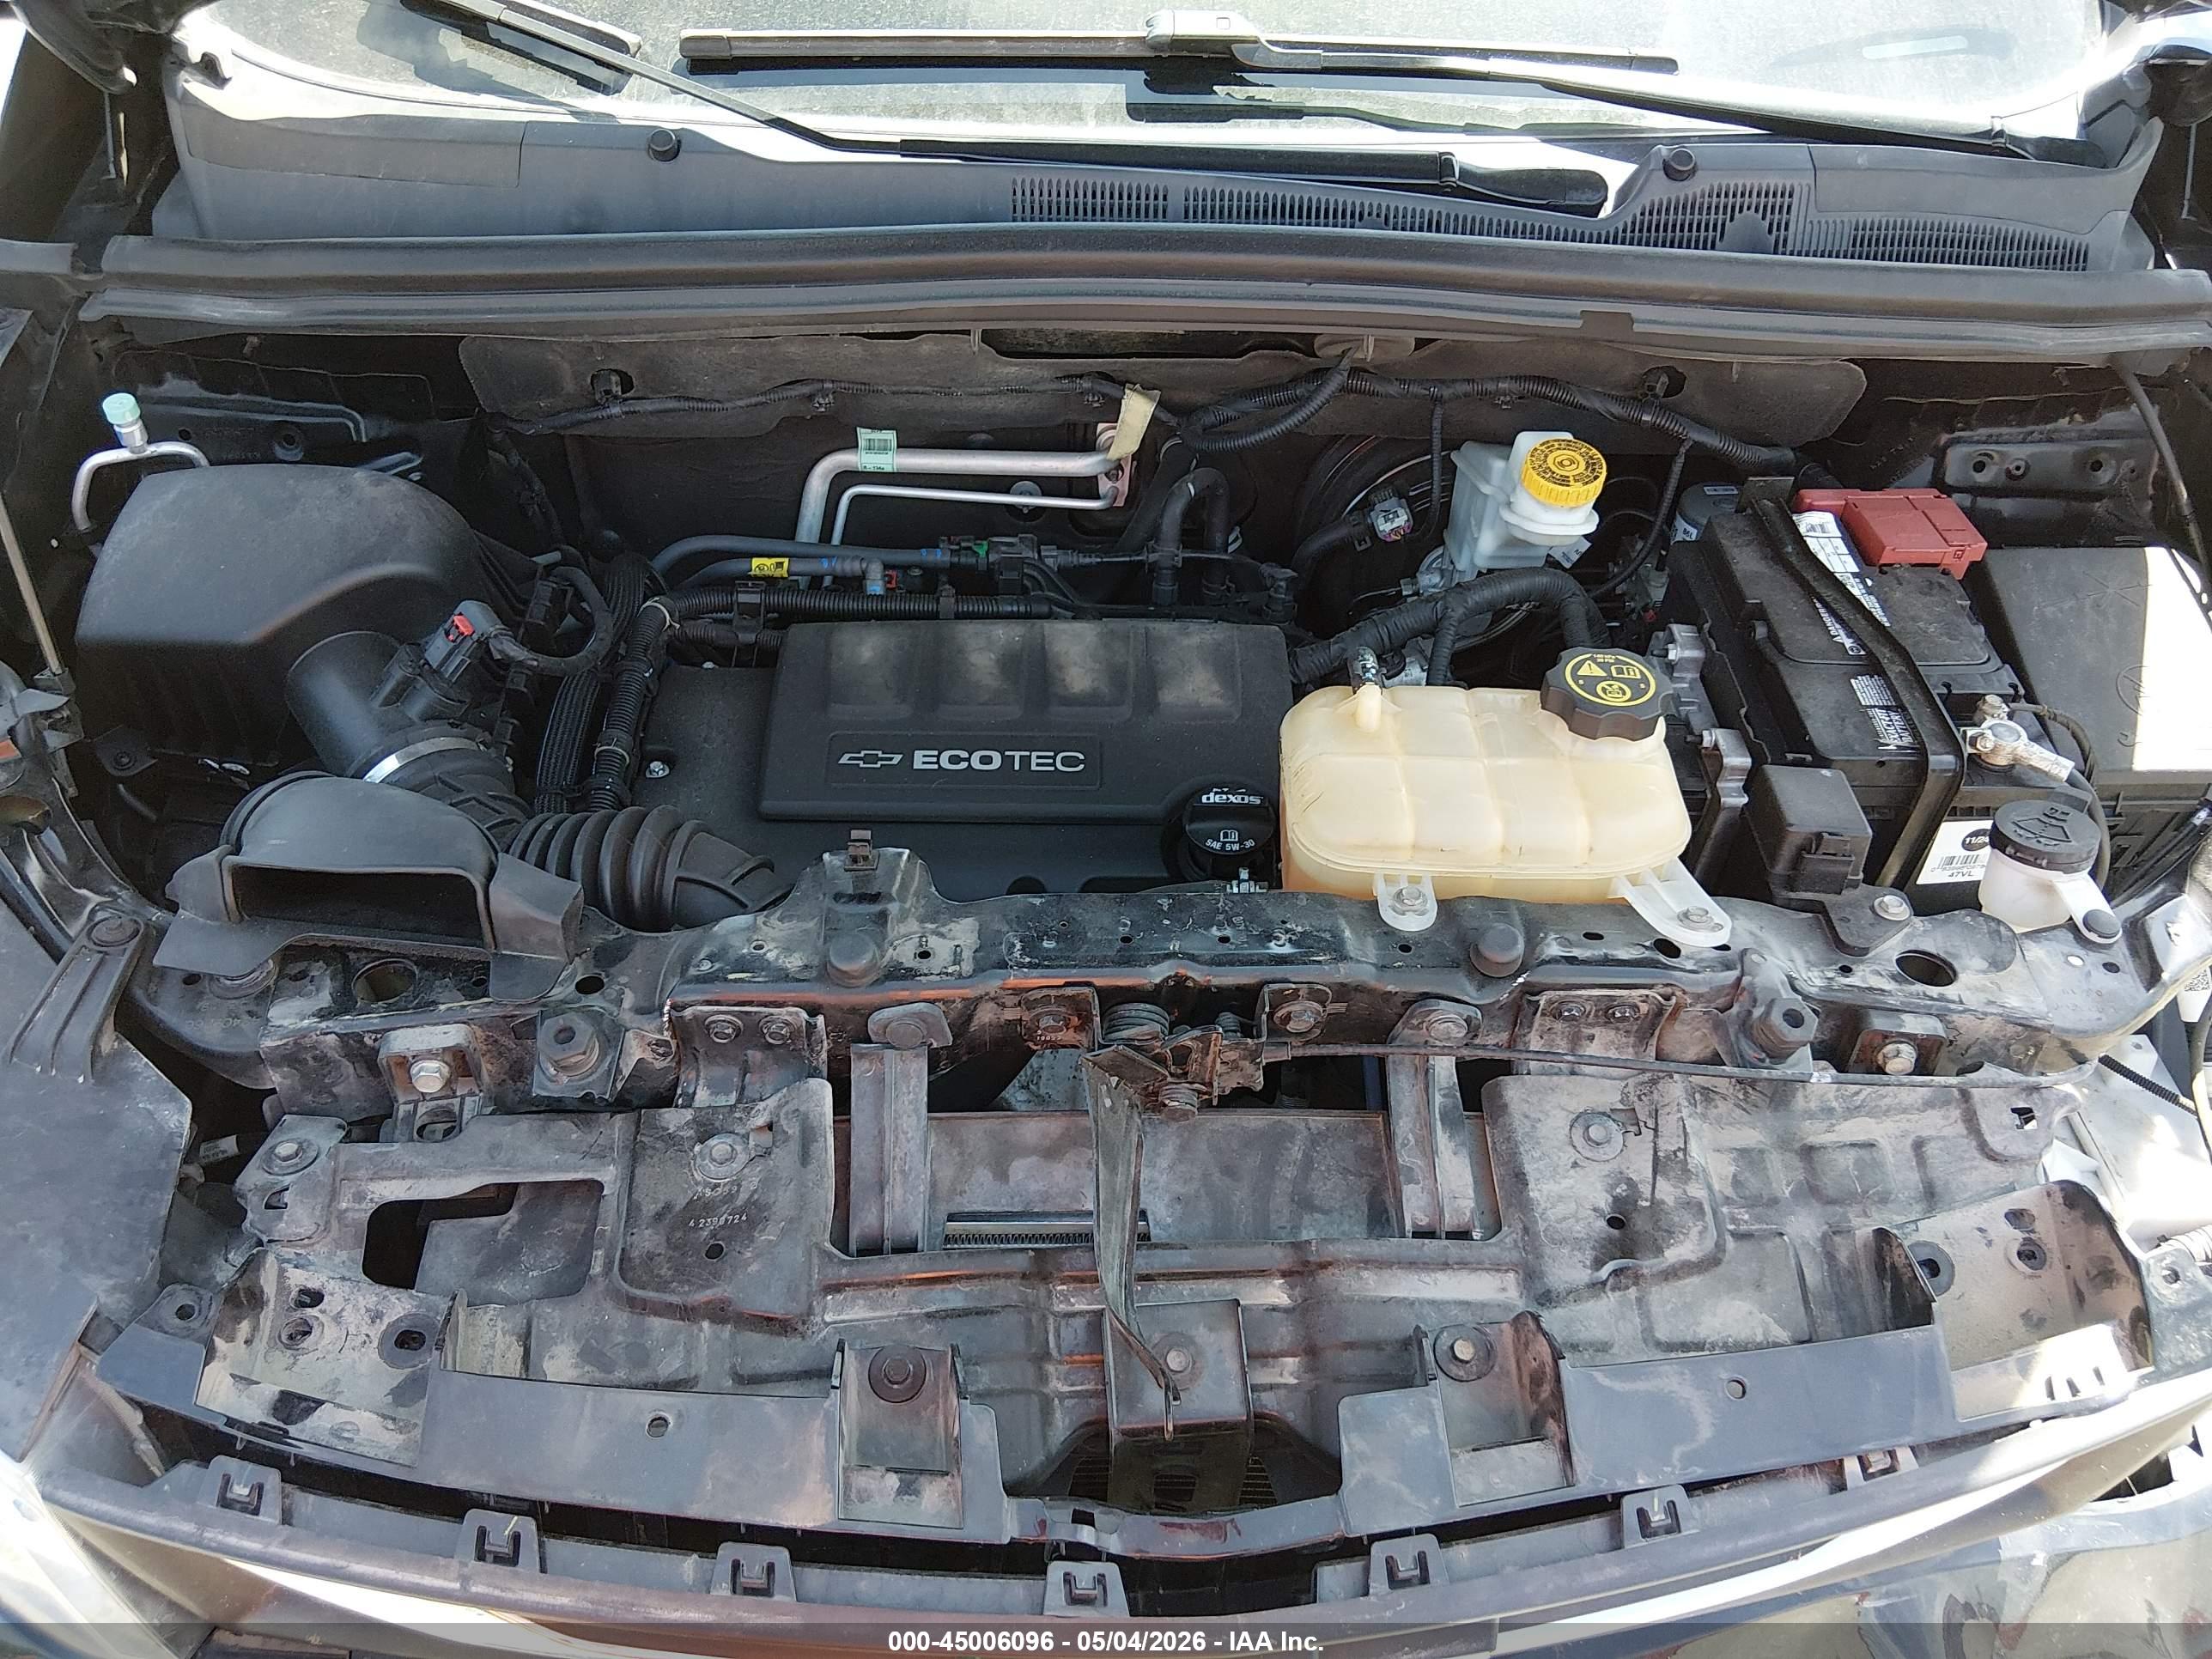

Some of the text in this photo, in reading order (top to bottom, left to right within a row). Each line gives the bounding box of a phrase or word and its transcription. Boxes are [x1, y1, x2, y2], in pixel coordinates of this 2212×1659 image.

[1887, 710, 1913, 742] BATTERY
[913, 750, 1085, 772] ECOTEC
[1201, 792, 1261, 805] dexos
[1205, 838, 1255, 851] SAE 5W-30
